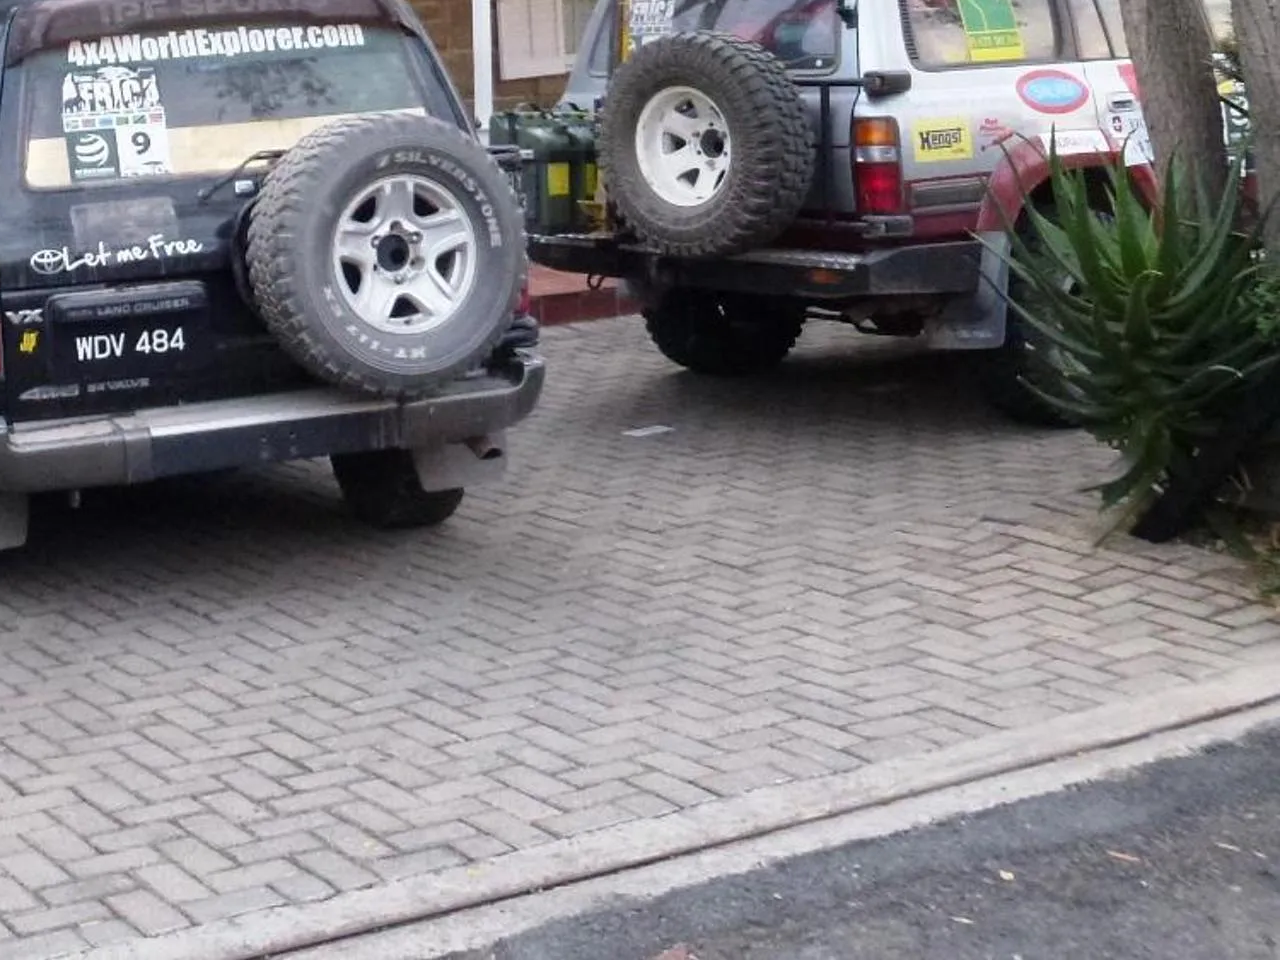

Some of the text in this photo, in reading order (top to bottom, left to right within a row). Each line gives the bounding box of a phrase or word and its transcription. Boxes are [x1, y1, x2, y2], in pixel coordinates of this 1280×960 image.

[67, 24, 365, 69] 4x4WorldExplorer.com
[131, 131, 151, 155] 9
[393, 151, 503, 248] SILVERSTONE
[63, 233, 203, 272] Let me Free
[5, 309, 45, 324] VX
[75, 326, 187, 362] WDV 484
